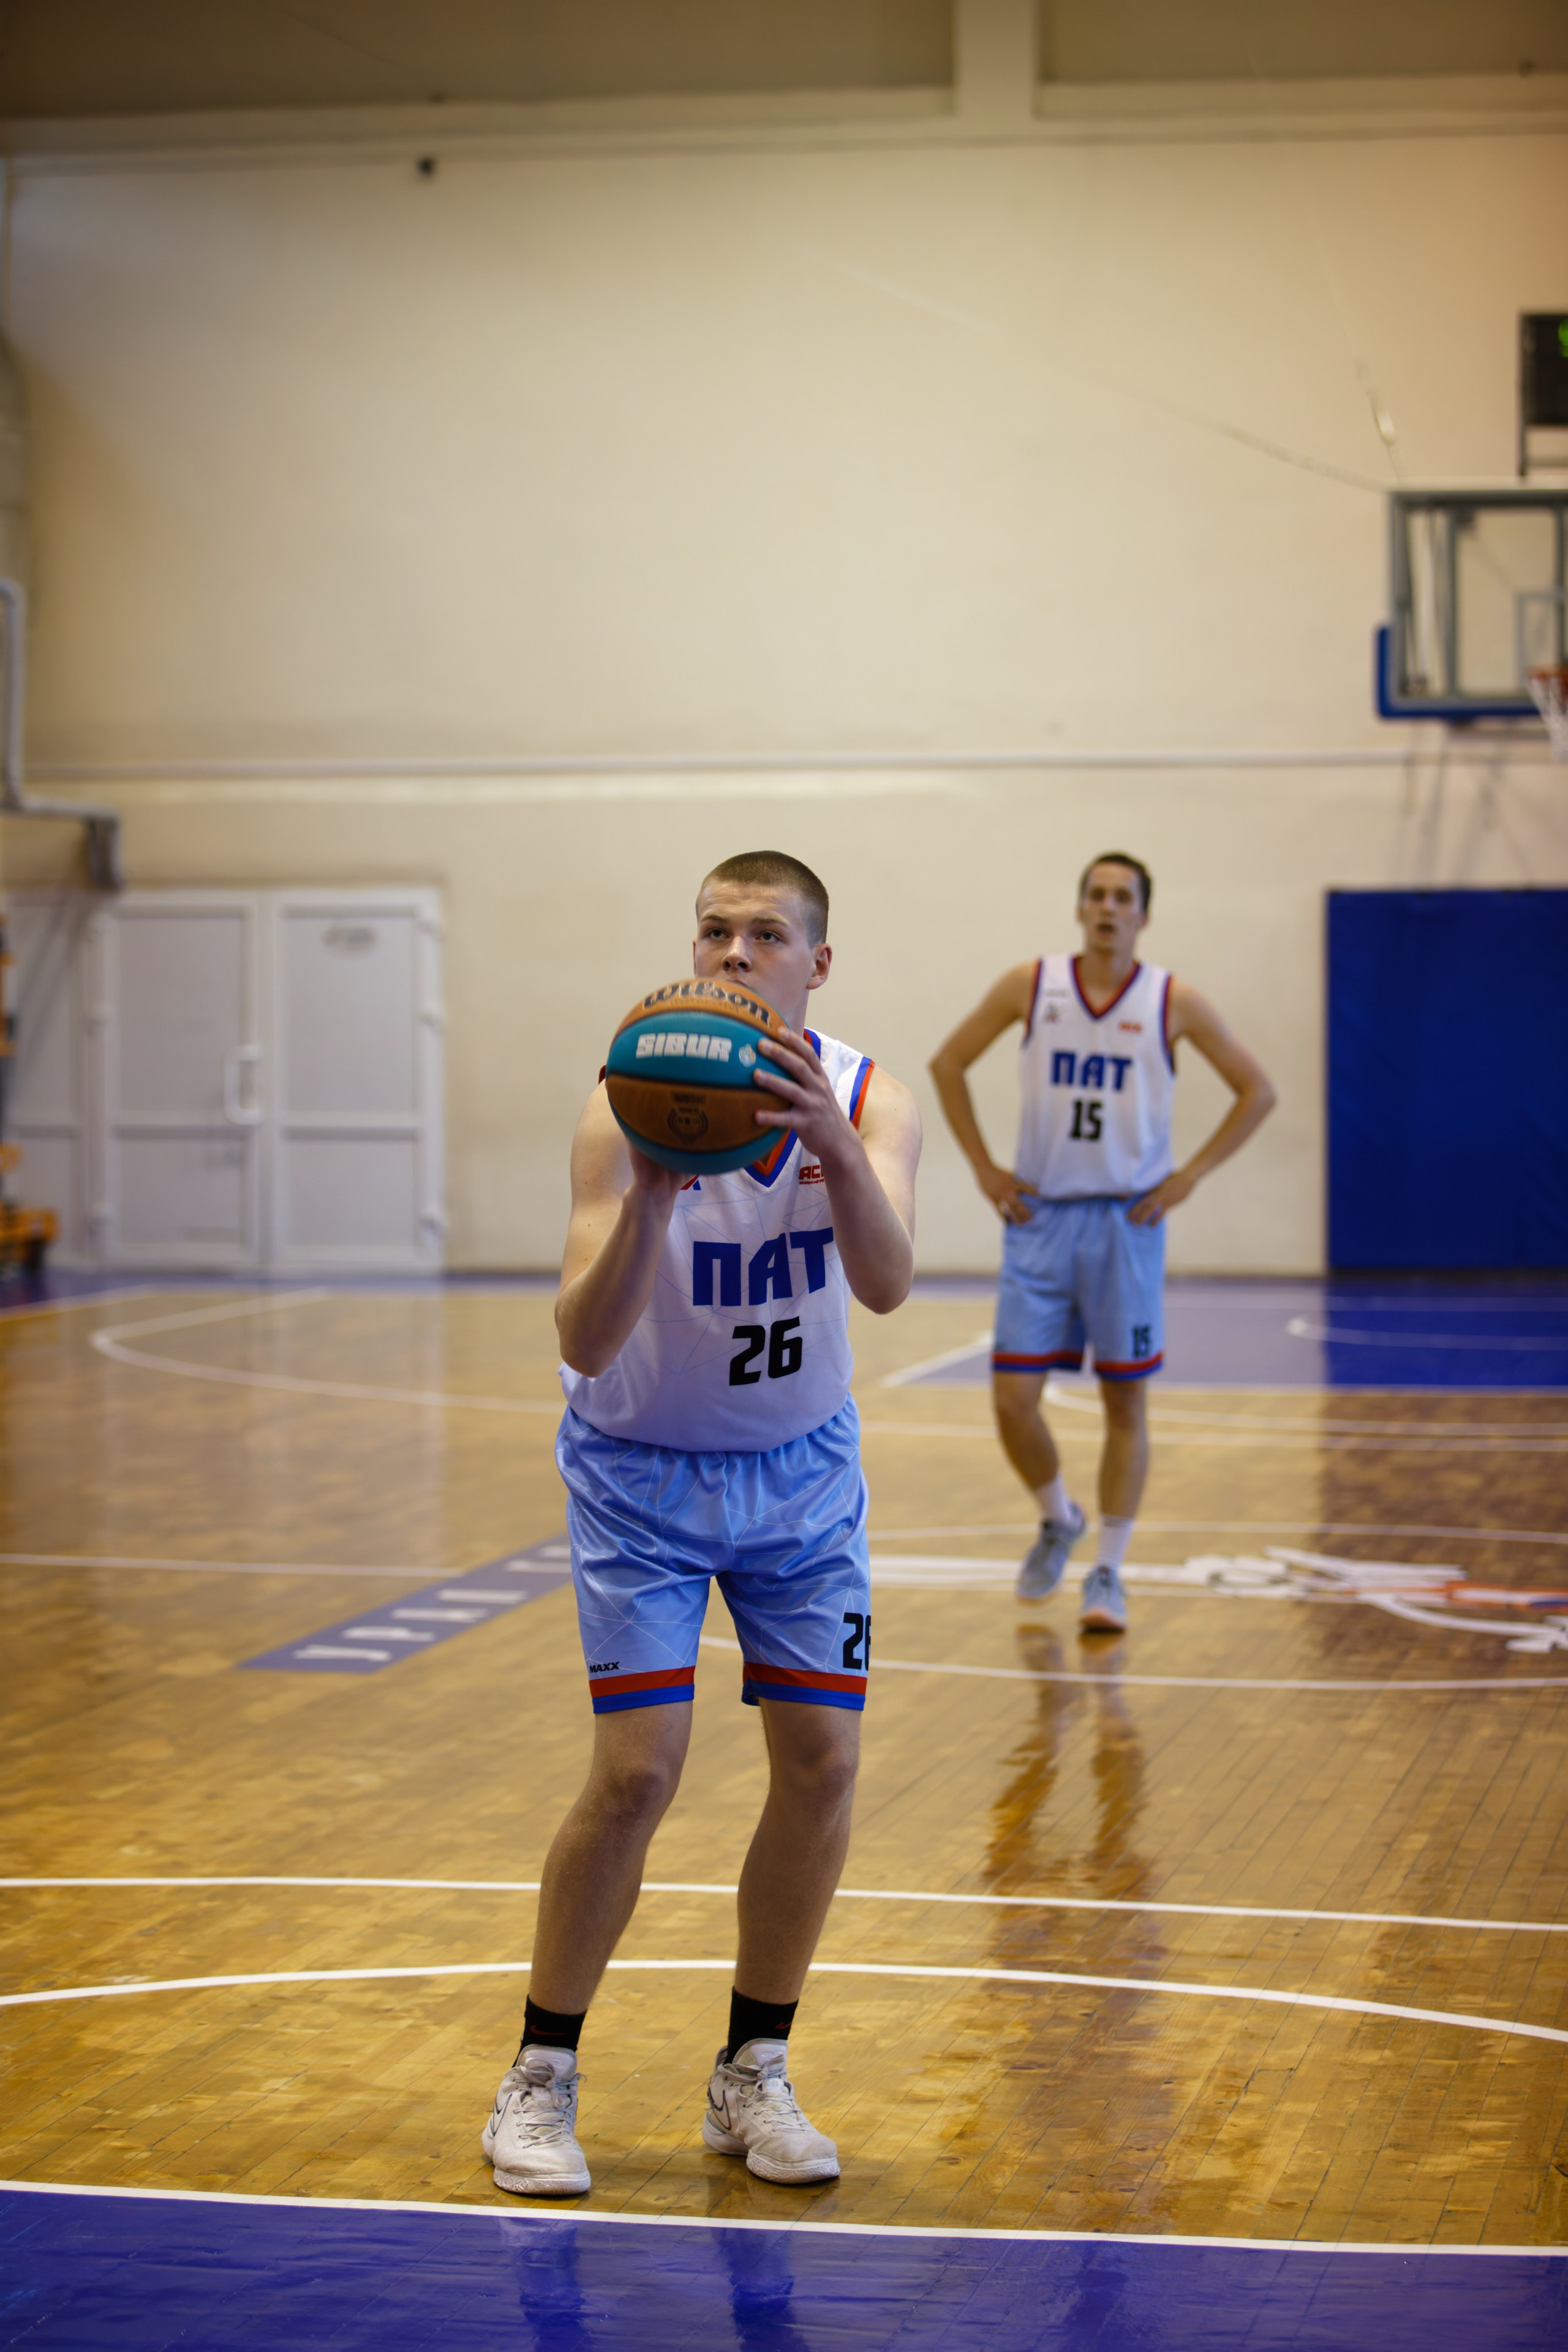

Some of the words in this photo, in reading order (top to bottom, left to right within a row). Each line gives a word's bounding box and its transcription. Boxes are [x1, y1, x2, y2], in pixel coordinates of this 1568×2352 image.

[636, 1032, 732, 1063] SIBUR
[1051, 1050, 1133, 1092] ПАТ
[1071, 1099, 1102, 1142] 15
[799, 1164, 824, 1180] АС
[693, 1226, 834, 1306] ПАТ
[728, 1316, 803, 1386] 26
[1132, 1325, 1152, 1358] 15
[589, 1661, 620, 1673] MAXX
